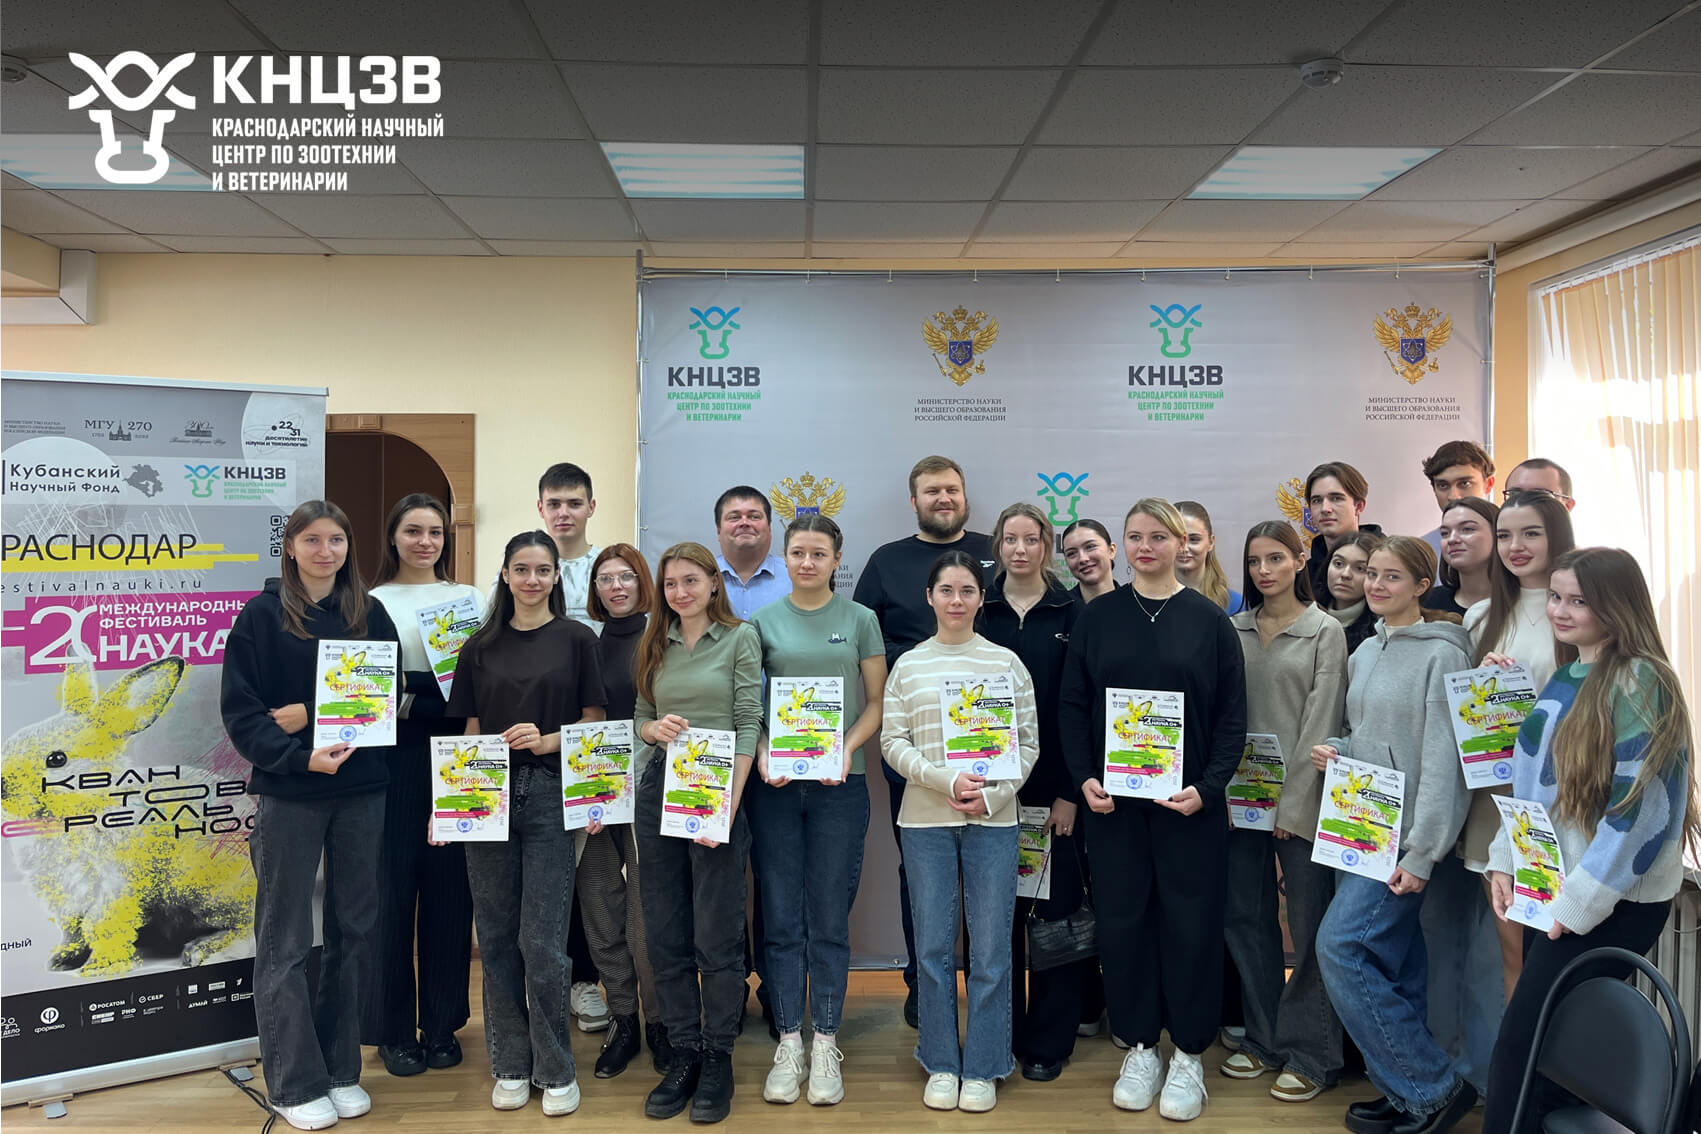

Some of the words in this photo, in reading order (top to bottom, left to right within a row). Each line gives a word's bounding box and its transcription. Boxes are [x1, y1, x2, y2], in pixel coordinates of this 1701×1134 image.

[668, 366, 761, 389] КНЦЗВ
[1128, 365, 1223, 388] КНЦЗВ
[667, 390, 726, 401] КРАСНОДАРСКИЙ
[728, 390, 762, 400] НАУЧНЫЙ
[1128, 389, 1188, 400] КРАСНОДАРСКИЙ
[1190, 389, 1224, 399] НАУЧНЫЙ
[677, 402, 698, 411] ЦЕНТР
[711, 402, 752, 411] ЗООТЕХНИИ
[1137, 401, 1160, 411] ЦЕНТР
[1174, 401, 1214, 410] ЗООТЕХНИИ
[693, 413, 742, 421] ВЕТЕРИНАРИИ
[914, 414, 964, 422] РОССИЙСКОЙ
[964, 414, 1006, 422] ФЕДЕРАЦИИ
[1154, 412, 1204, 421] ВЕТЕРИНАРИИ
[1365, 413, 1415, 421] РОССИЙСКОЙ
[1416, 413, 1460, 421] ФЕДЕРАЦИИ
[84, 419, 114, 430] МГУ
[128, 420, 153, 432] 270
[10, 463, 121, 480] Кубанский
[224, 466, 286, 481] КНЦЗВ
[10, 481, 76, 494] Научный
[81, 482, 121, 494] Фонд
[1, 533, 197, 566] РАСНОДАР
[1, 578, 202, 593] estivalnauki.ru
[99, 600, 248, 616] МЕЖДУНАРОДНЫ
[99, 615, 208, 629] ФЕСТИВАЛЬ
[99, 629, 229, 662] НАУКА
[1466, 709, 1528, 726] СЕРТИФИКАТ
[97, 1000, 126, 1010] РОСАТОМ
